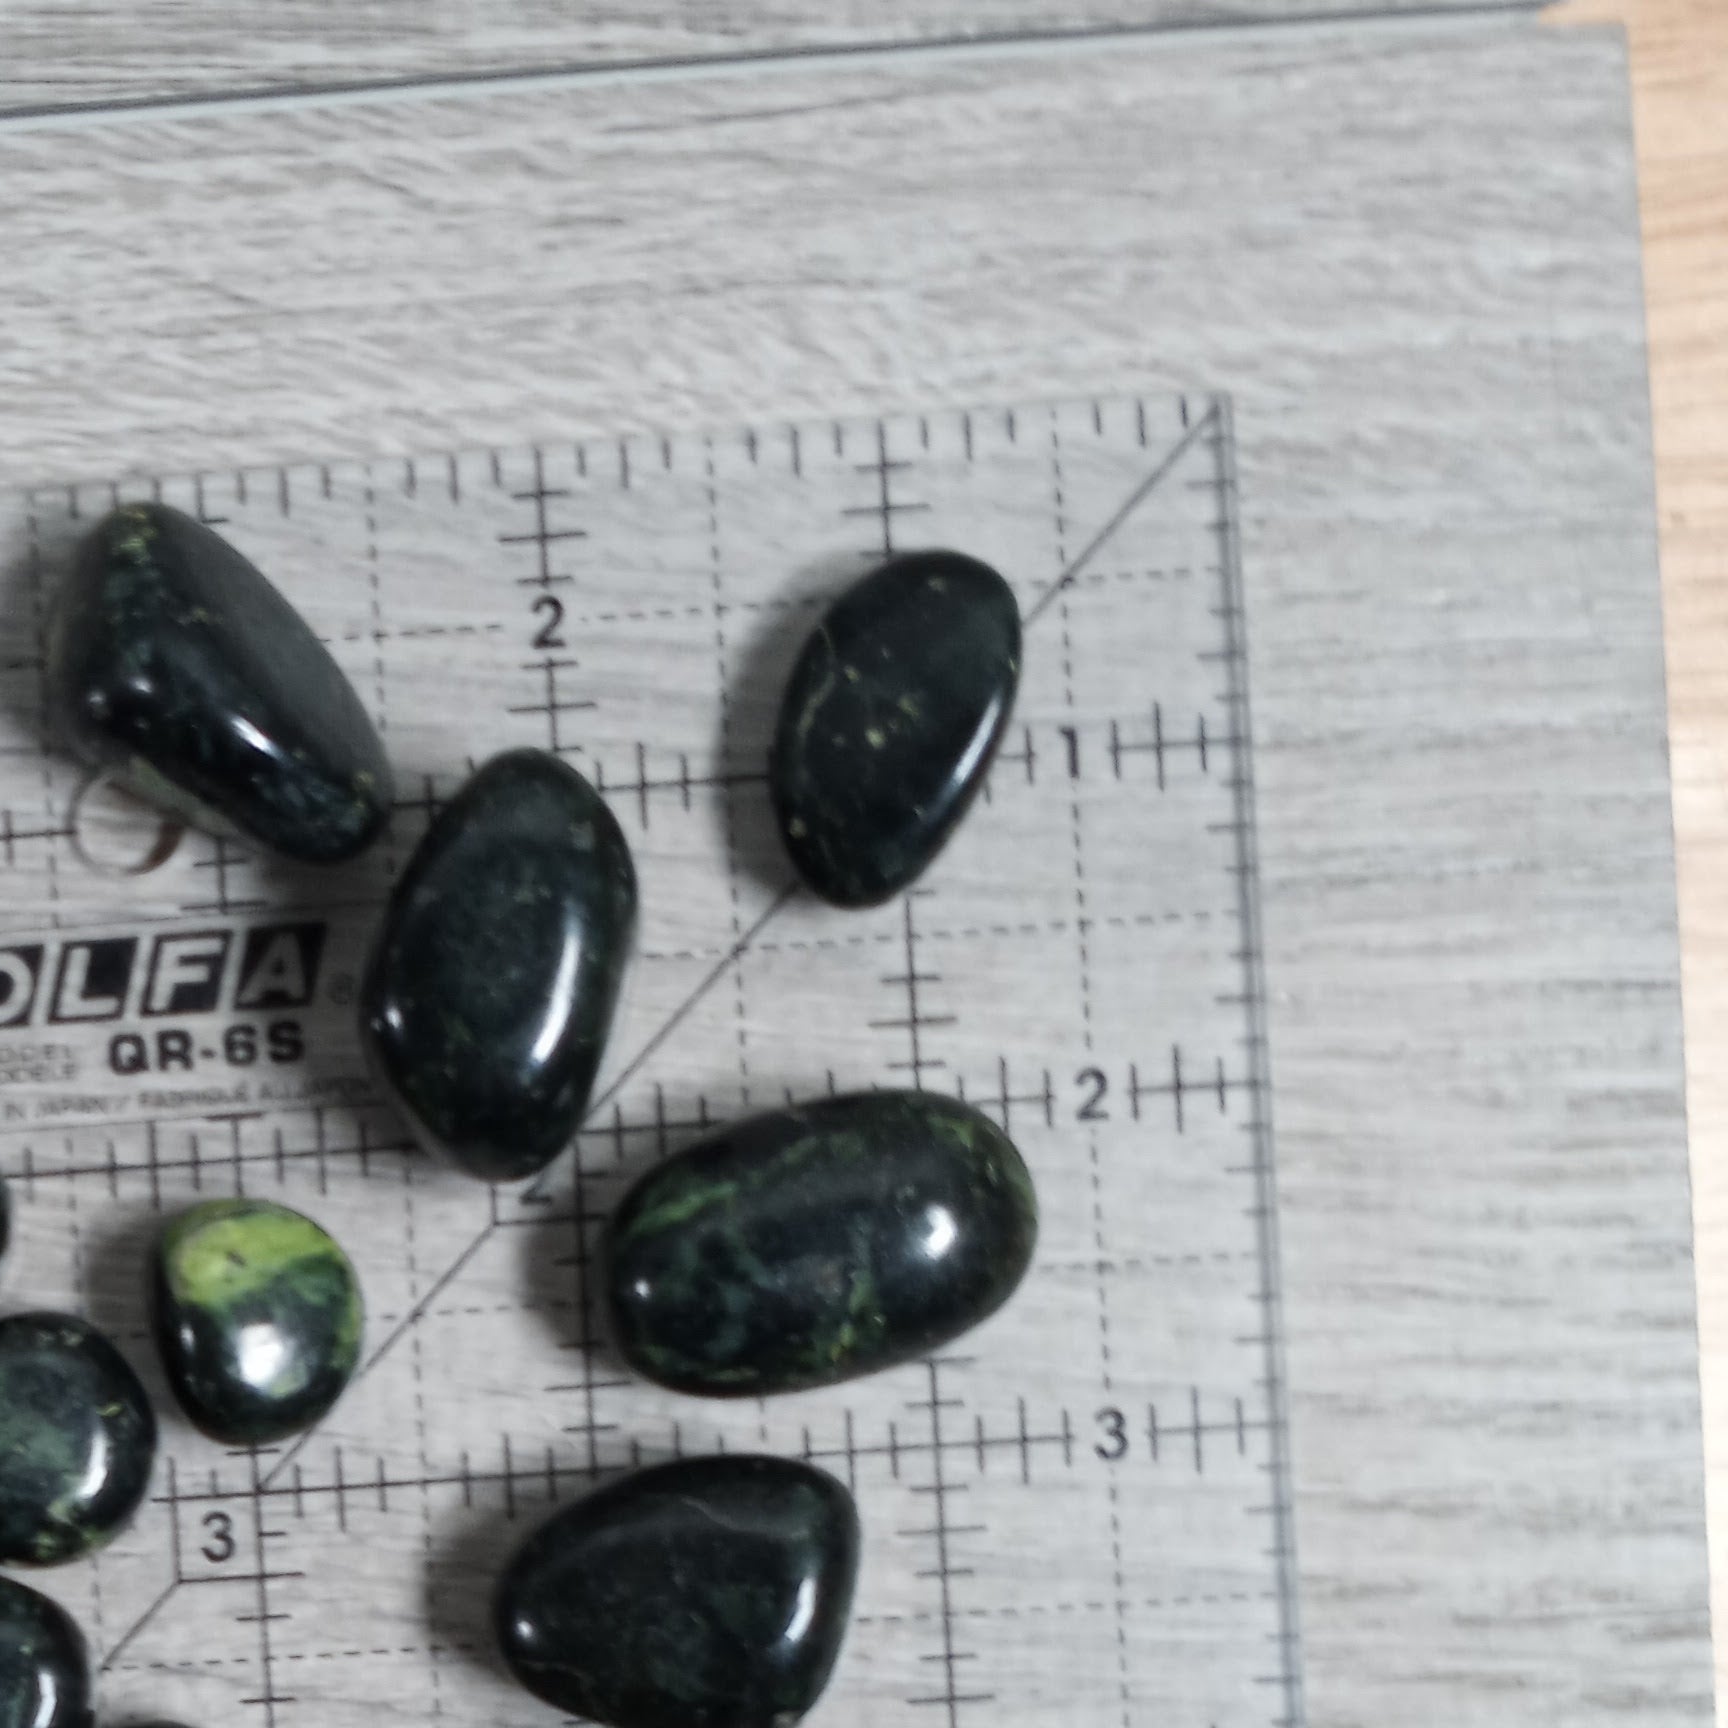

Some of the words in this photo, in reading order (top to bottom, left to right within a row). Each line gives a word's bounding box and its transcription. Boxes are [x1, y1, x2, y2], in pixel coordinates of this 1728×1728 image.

[531, 595, 567, 649] 2
[1058, 725, 1080, 780] 1
[109, 1020, 304, 1074] QR-6S
[1075, 1066, 1109, 1121] 2
[1094, 1406, 1129, 1462] 3
[201, 1510, 235, 1563] 3
